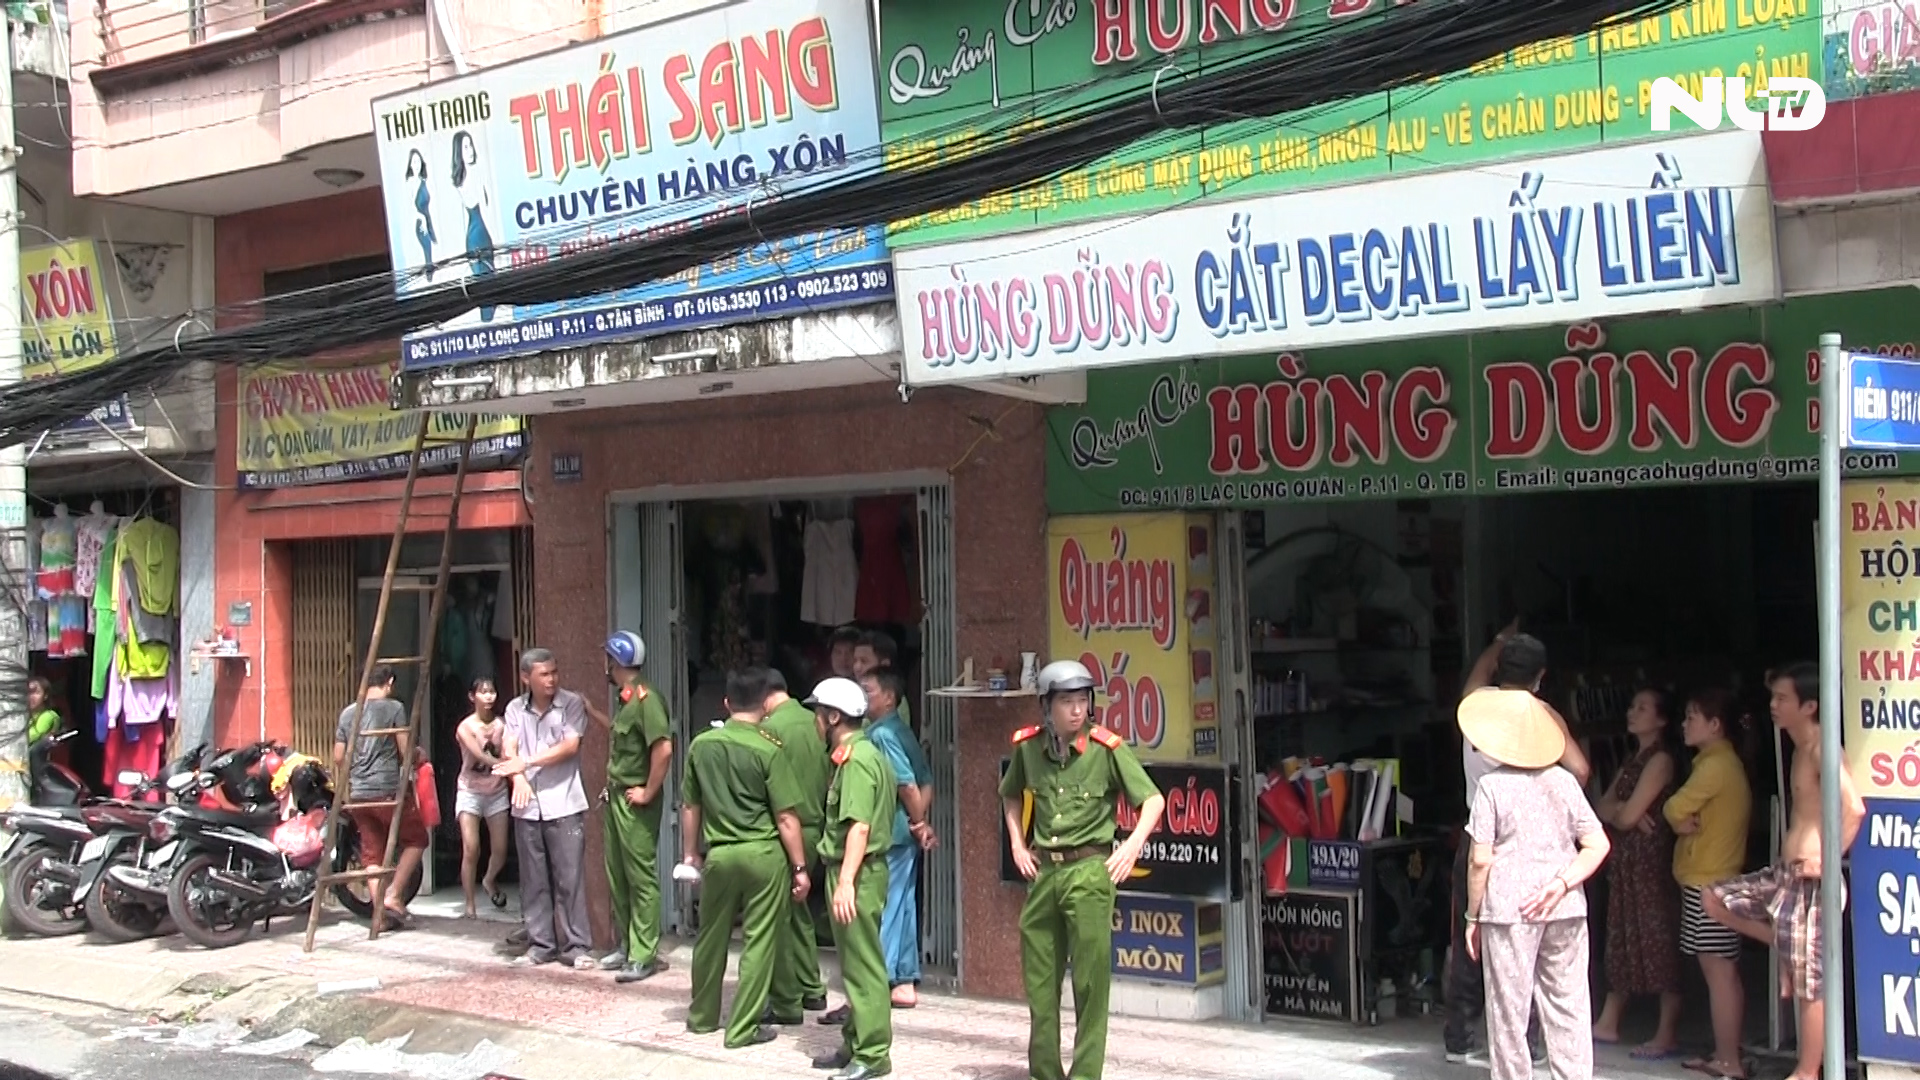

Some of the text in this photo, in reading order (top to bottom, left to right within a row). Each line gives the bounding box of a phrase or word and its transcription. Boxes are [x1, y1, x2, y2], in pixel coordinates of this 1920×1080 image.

[1670, 0, 1726, 40] KIM
[889, 27, 999, 108] Quảng
[382, 91, 492, 142] THỜI TRANG
[509, 16, 840, 183] THÁI SANG
[1386, 117, 1426, 156] ALU
[1481, 92, 1546, 138] CHÂN
[1554, 85, 1619, 130] DUNG
[515, 175, 646, 230] CHUYÊN
[658, 156, 757, 203] HÀNG
[767, 133, 847, 178] XÔN
[917, 152, 1741, 367] HÙNG DŨNG CẮT DECAL LẤY LIỀN
[27, 258, 96, 320] XÔN
[430, 337, 463, 357] 911/10
[466, 333, 487, 355] LẠC
[489, 328, 519, 347] LONG
[521, 321, 553, 343] QUÂN
[562, 317, 586, 335] P.11
[634, 302, 665, 325] BÌNH
[674, 301, 695, 320] ĐT:
[696, 290, 761, 316] 0165.3530
[763, 284, 788, 306] 113
[797, 273, 859, 299] 0902.523
[862, 269, 888, 289] 309
[58, 324, 104, 360] LỚN
[1206, 353, 1457, 475] HÙNG
[1483, 321, 1780, 458] DŨNG
[1853, 376, 1887, 419] HẺM
[1890, 388, 1920, 424] 911/
[1151, 485, 1196, 506] 911/8
[1240, 481, 1287, 500] LONG
[1293, 474, 1345, 499] QUÂN
[1360, 474, 1398, 494] P.11
[1496, 468, 1558, 489] Email:
[1563, 452, 1898, 488] quangcaohugdung@gma.com
[1851, 487, 1920, 531] BẢN
[1059, 524, 1175, 650] Quảng
[1167, 776, 1219, 837] CÁO
[1196, 844, 1219, 864] 714
[1312, 844, 1359, 869] 49A/20
[1130, 909, 1184, 937] INOX
[1301, 902, 1343, 929] NÓNG
[1116, 944, 1185, 973] MÒN
